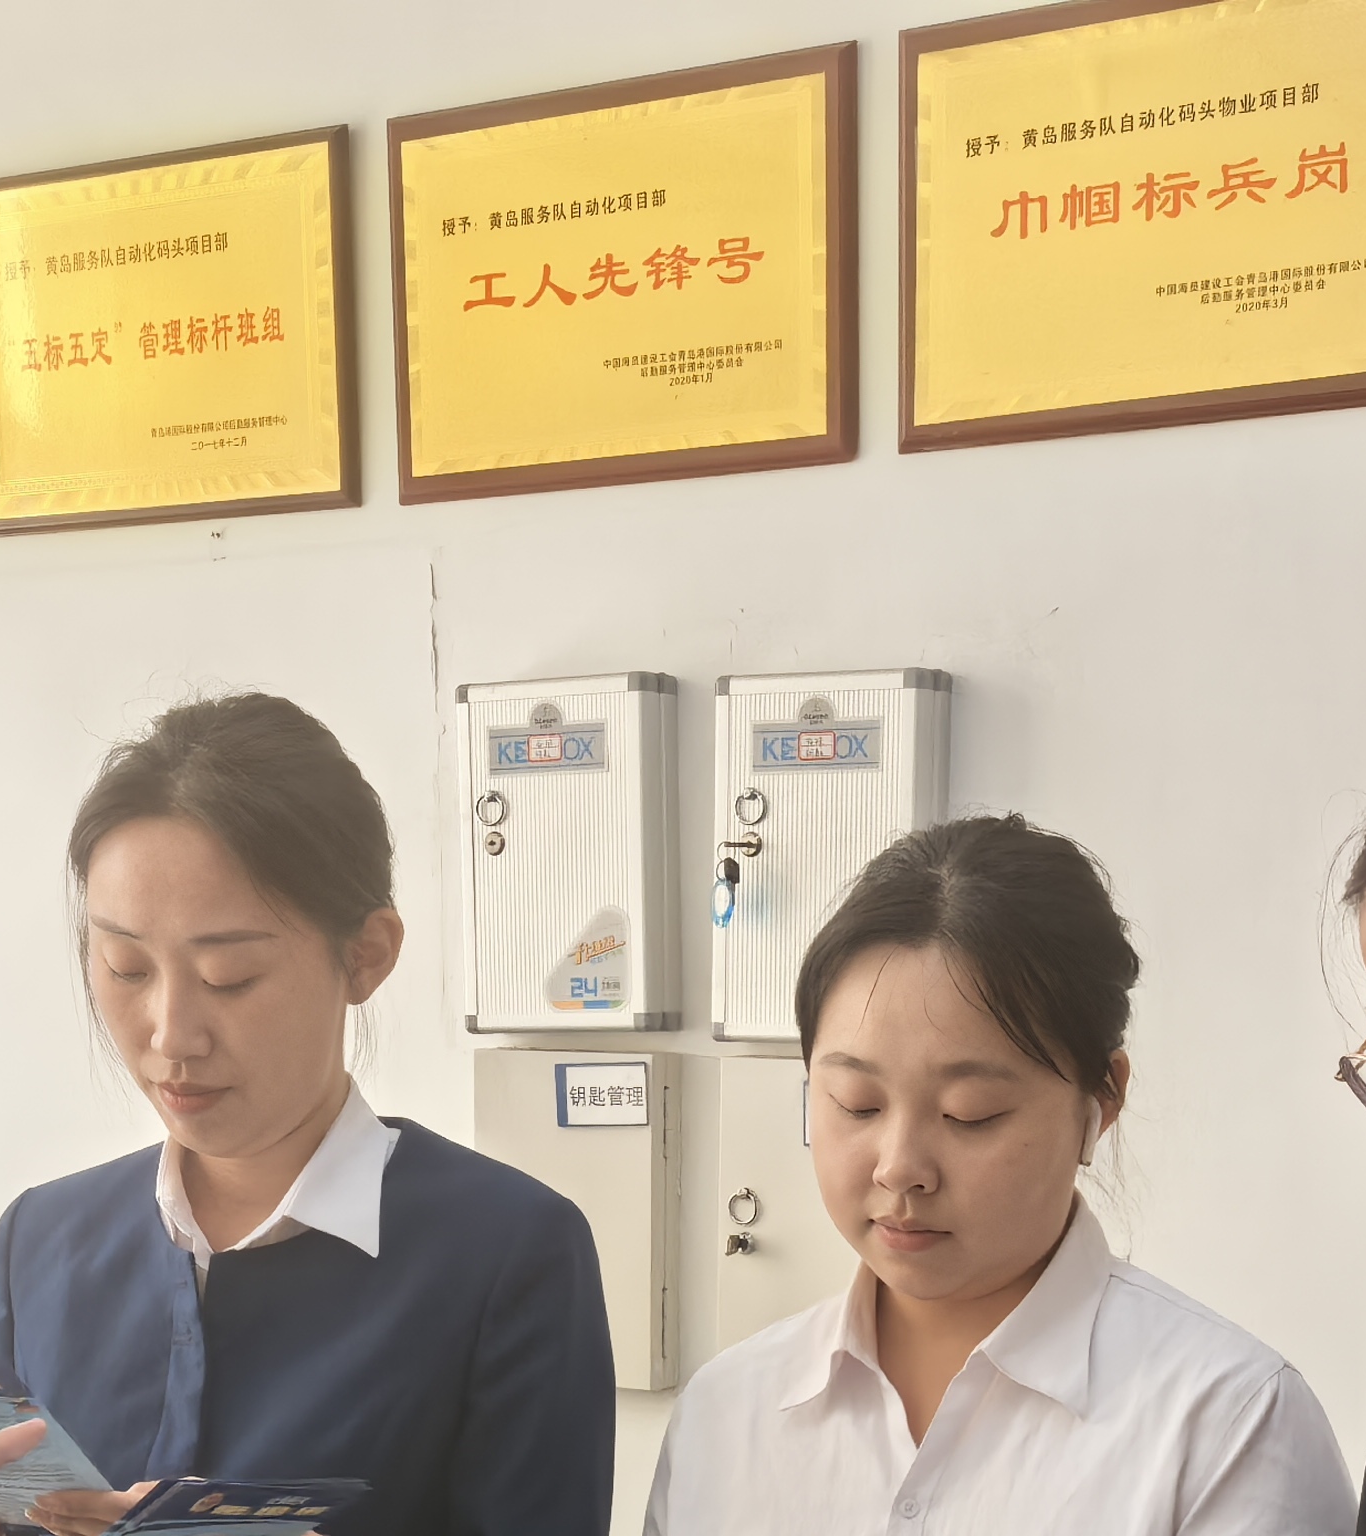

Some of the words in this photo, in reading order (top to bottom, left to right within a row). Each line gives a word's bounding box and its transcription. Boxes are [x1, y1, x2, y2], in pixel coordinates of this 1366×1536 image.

[965, 82, 1320, 159] 授予：黄岛服务队自动化码头物业项目部
[990, 141, 1349, 240] 巾帼标兵岗
[441, 188, 666, 238] 授予：黄岛服务队自动化项目部
[462, 236, 765, 313] 工人先锋号
[1235, 296, 1289, 313] 2020年3月
[669, 372, 713, 387] 2020年1月
[498, 736, 595, 764] KEOX
[762, 734, 869, 762] KEOX
[570, 976, 598, 998] 24
[569, 1085, 644, 1107] 钥匙管理
